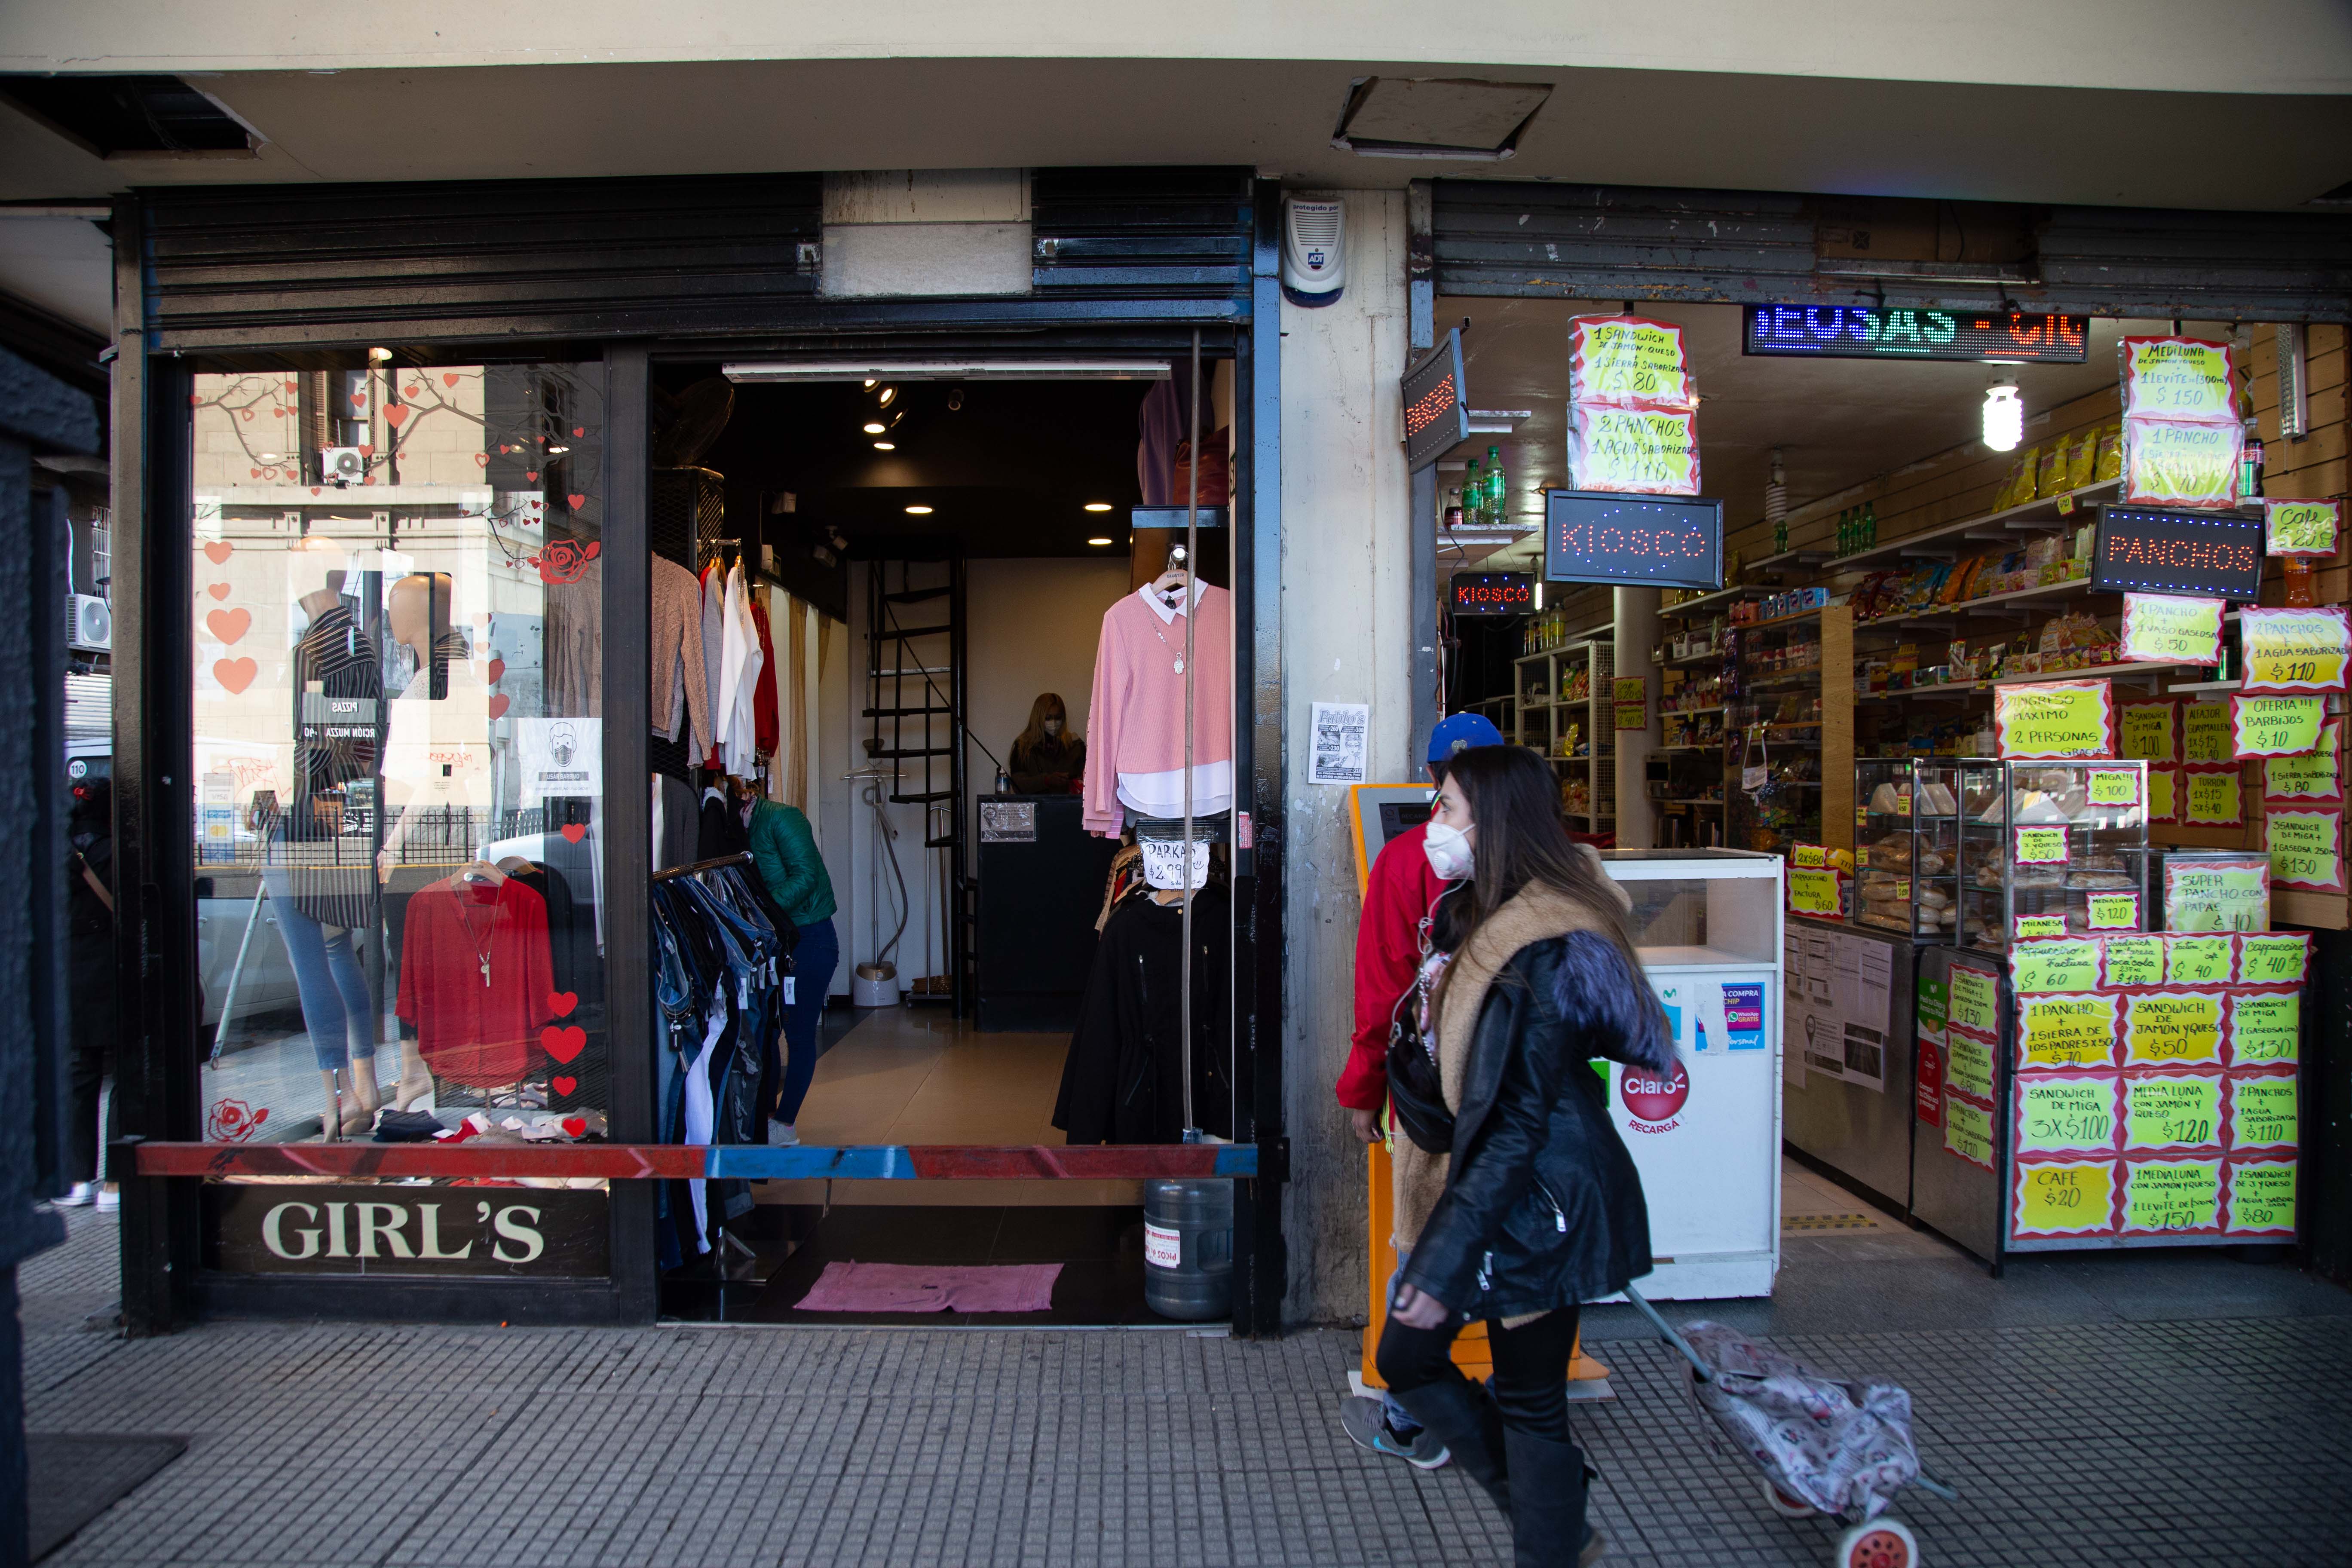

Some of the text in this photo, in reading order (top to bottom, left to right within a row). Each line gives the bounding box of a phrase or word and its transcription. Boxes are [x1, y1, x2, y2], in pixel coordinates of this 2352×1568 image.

[1648, 346, 1675, 356] QUESO
[1633, 372, 1656, 391] 80
[2173, 390, 2203, 405] 150
[1614, 415, 1685, 437] PANCHOS
[2164, 429, 2218, 444] PANCHO
[1605, 438, 1638, 454] AGUA
[1628, 462, 1668, 482] 110
[1562, 524, 1706, 557] KIOSCO
[2109, 536, 2253, 571] PANCHOS
[1458, 587, 1530, 603] KIOSCO
[2150, 604, 2197, 617] PANCHO
[2147, 625, 2176, 635] VASO
[2264, 623, 2324, 634] PANCHOS
[2168, 639, 2187, 652] 50
[2264, 649, 2294, 658] AGUA
[2286, 662, 2315, 681] 110
[2254, 700, 2297, 713] OFERTA
[2014, 710, 2068, 720] MAXIMO
[2189, 709, 2220, 720] ALFAJOR
[2030, 731, 2098, 743] PERSONAS
[2271, 731, 2288, 747] 10
[2140, 735, 2159, 756] 100
[71, 765, 85, 774] 110
[2106, 785, 2127, 796] 100
[2295, 781, 2309, 793] 80
[2279, 844, 2311, 854] GASEOSA
[2182, 875, 2223, 886] SUPER
[1795, 890, 1821, 900] FACTURA
[2182, 888, 2239, 899] PANCHO
[2107, 907, 2127, 919] 120
[2183, 902, 2223, 912] PAPAS
[2266, 957, 2286, 973] 40
[2195, 966, 2211, 978] 40
[2046, 974, 2068, 986] 60
[2042, 1003, 2094, 1016] PANCHO
[2084, 1026, 2102, 1035] DE
[1625, 1078, 1676, 1094] Claro
[2172, 1085, 2203, 1096] LUNA
[2248, 1087, 2293, 1098] PANCHOS
[2052, 1101, 2067, 1110] DE
[2135, 1110, 2170, 1118] QUESO
[1628, 1118, 1681, 1134] RECARGÁ
[2037, 1171, 2079, 1186] CAFE
